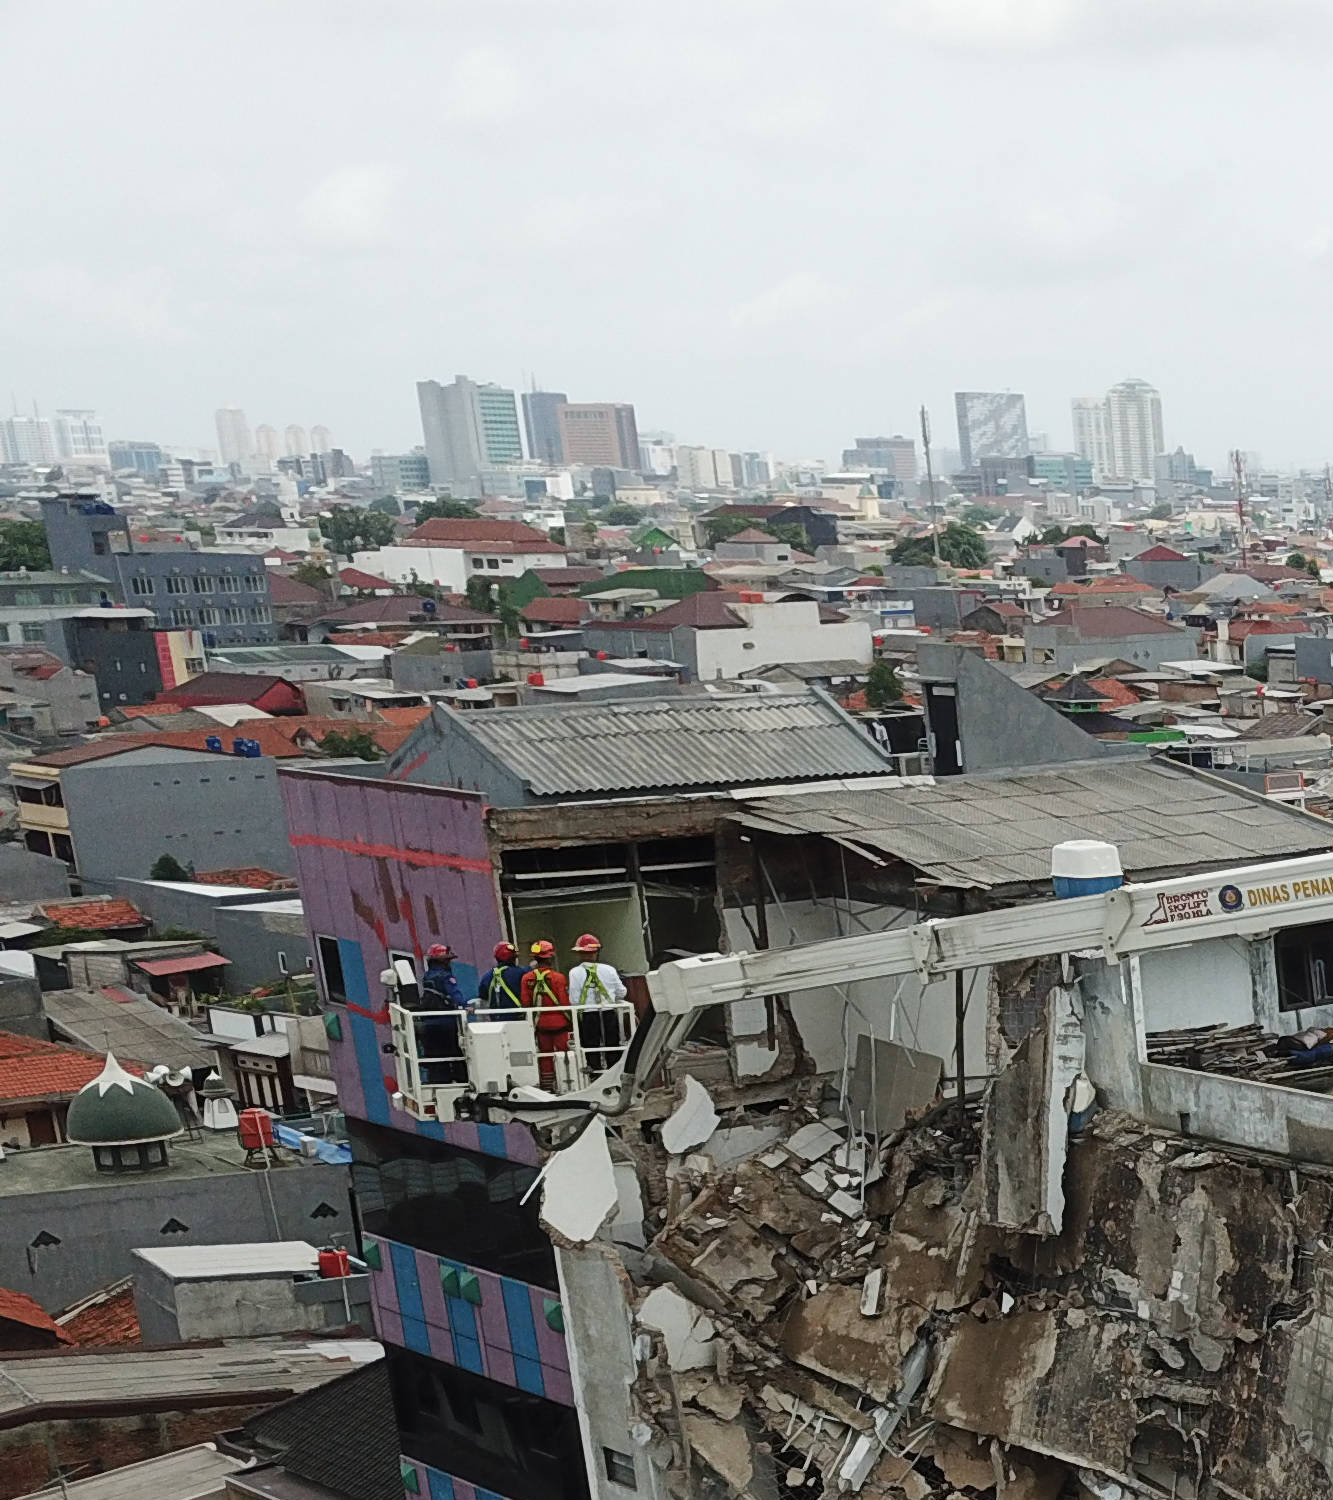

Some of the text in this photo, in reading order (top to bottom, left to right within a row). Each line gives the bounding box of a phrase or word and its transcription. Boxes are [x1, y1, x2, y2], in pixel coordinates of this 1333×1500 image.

[1165, 889, 1209, 905] BRONTO
[1247, 884, 1290, 907] DINAS
[1167, 899, 1209, 913] SKYLIFT
